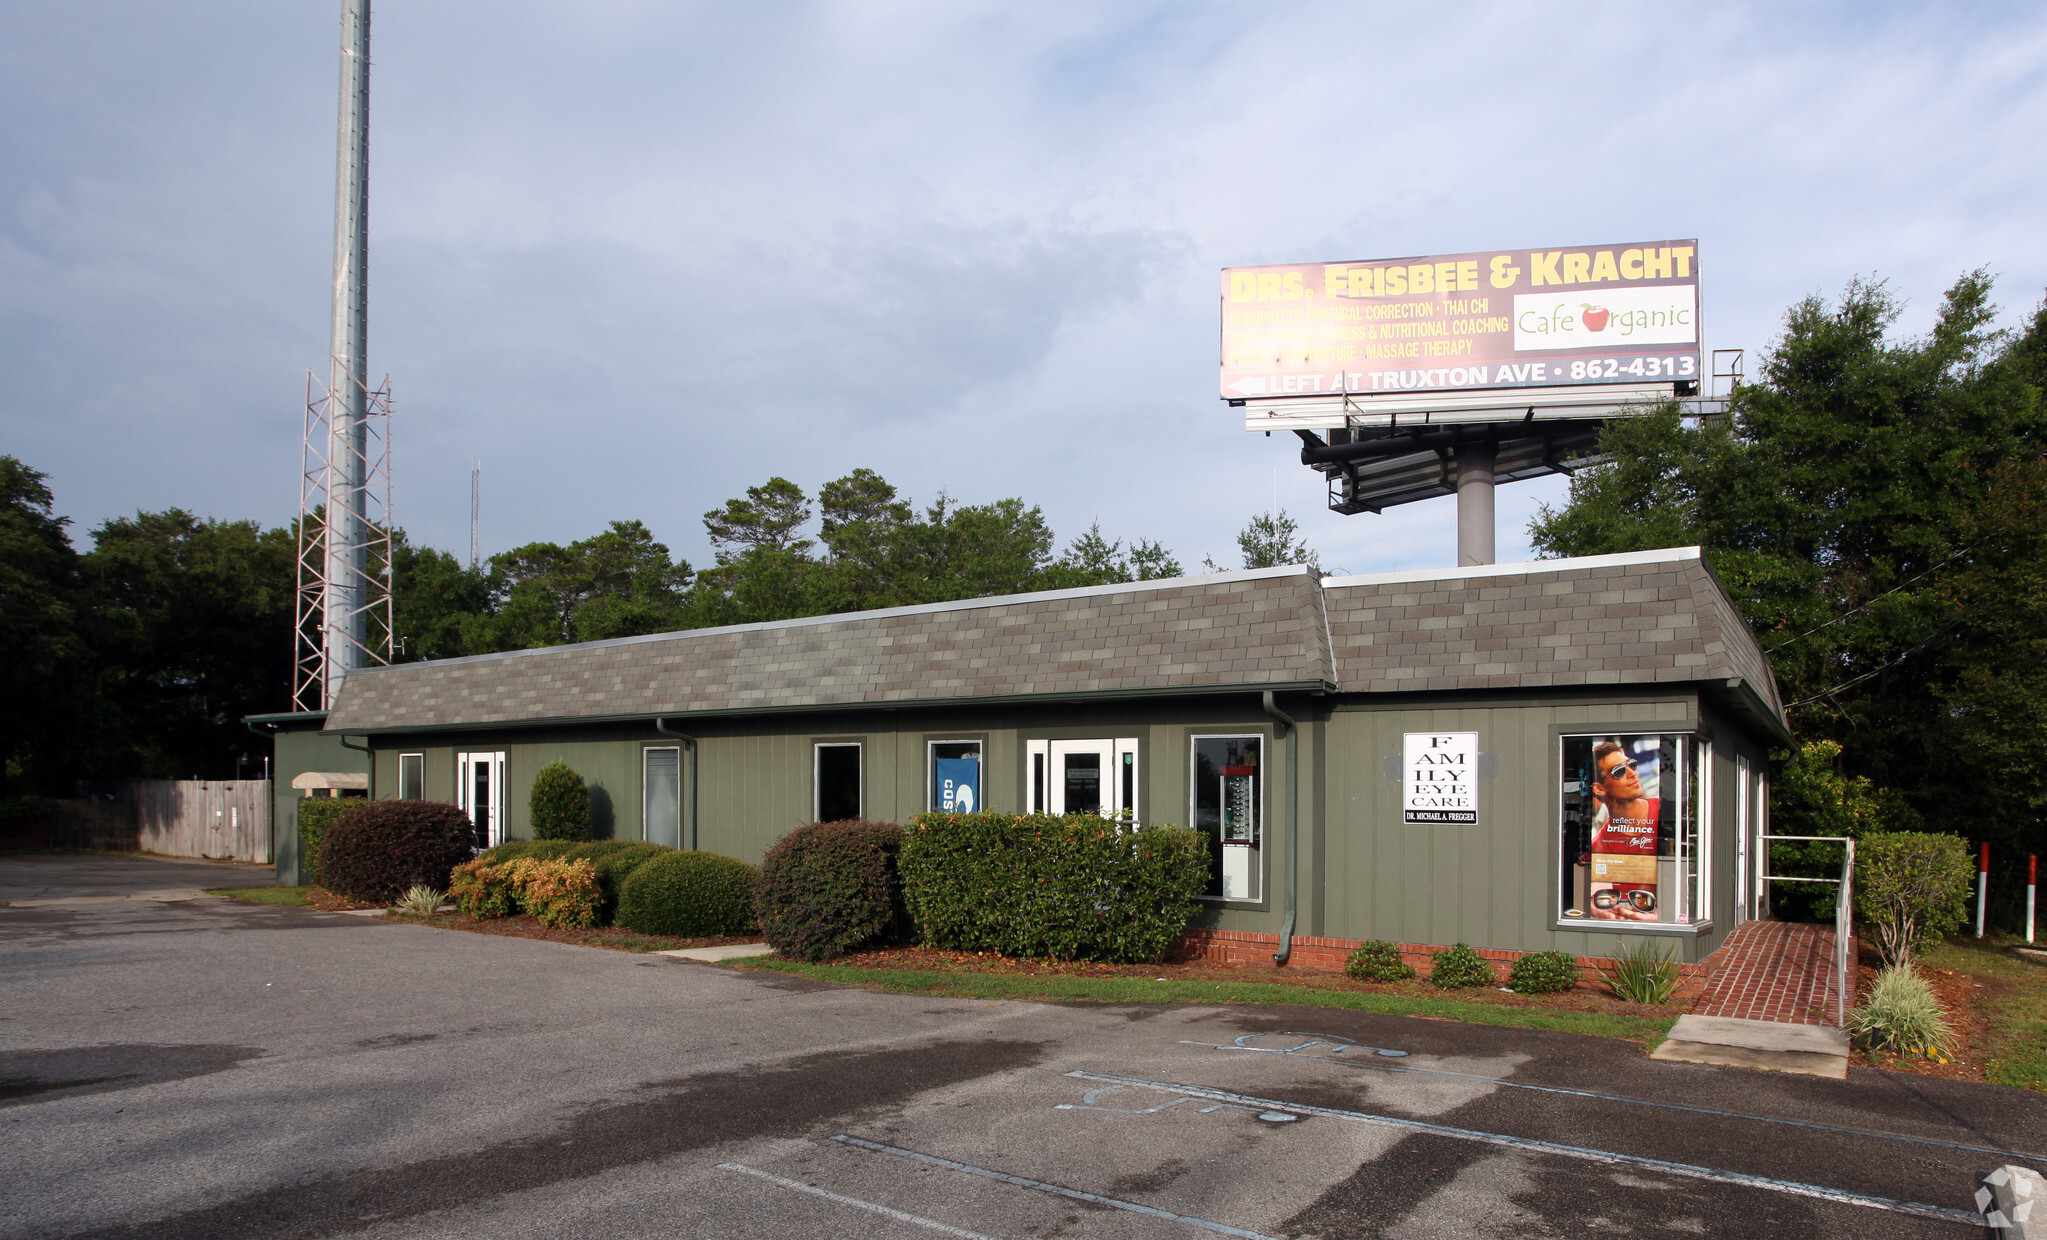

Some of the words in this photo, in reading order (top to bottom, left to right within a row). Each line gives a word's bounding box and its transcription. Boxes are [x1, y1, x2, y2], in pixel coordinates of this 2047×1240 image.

[1231, 271, 1314, 303] DRS.
[1325, 260, 1478, 298] FRISBEE
[1490, 256, 1521, 289] &
[1531, 246, 1694, 286] KRACHT
[1308, 306, 1362, 323] POSTURAL
[1365, 302, 1433, 320] CORRECTION
[1443, 299, 1468, 316] THAI
[1471, 298, 1489, 314] CHI
[1518, 303, 1574, 335] Cafe
[1323, 325, 1365, 342] FITNESS
[1369, 325, 1378, 340] &
[1380, 319, 1450, 339] NUTRITIONAL
[1453, 316, 1509, 334] COACHING
[1366, 341, 1419, 360] MASSAGE
[1423, 339, 1474, 357] THERAPY
[1270, 374, 1325, 393] LEFT
[1330, 373, 1362, 391] AT
[1367, 366, 1488, 390] TRUXTON
[1494, 363, 1547, 384] AVE
[1570, 355, 1695, 380] 862-4313
[1428, 737, 1452, 748] F
[1414, 753, 1467, 764] AM
[1413, 770, 1467, 781] ILY
[1414, 785, 1467, 794] EYE
[943, 779, 954, 813] COS
[1412, 797, 1469, 807] CARE
[1416, 812, 1441, 820] MICHAEL
[1636, 818, 1655, 826] your
[1606, 824, 1655, 834] brilliance.
